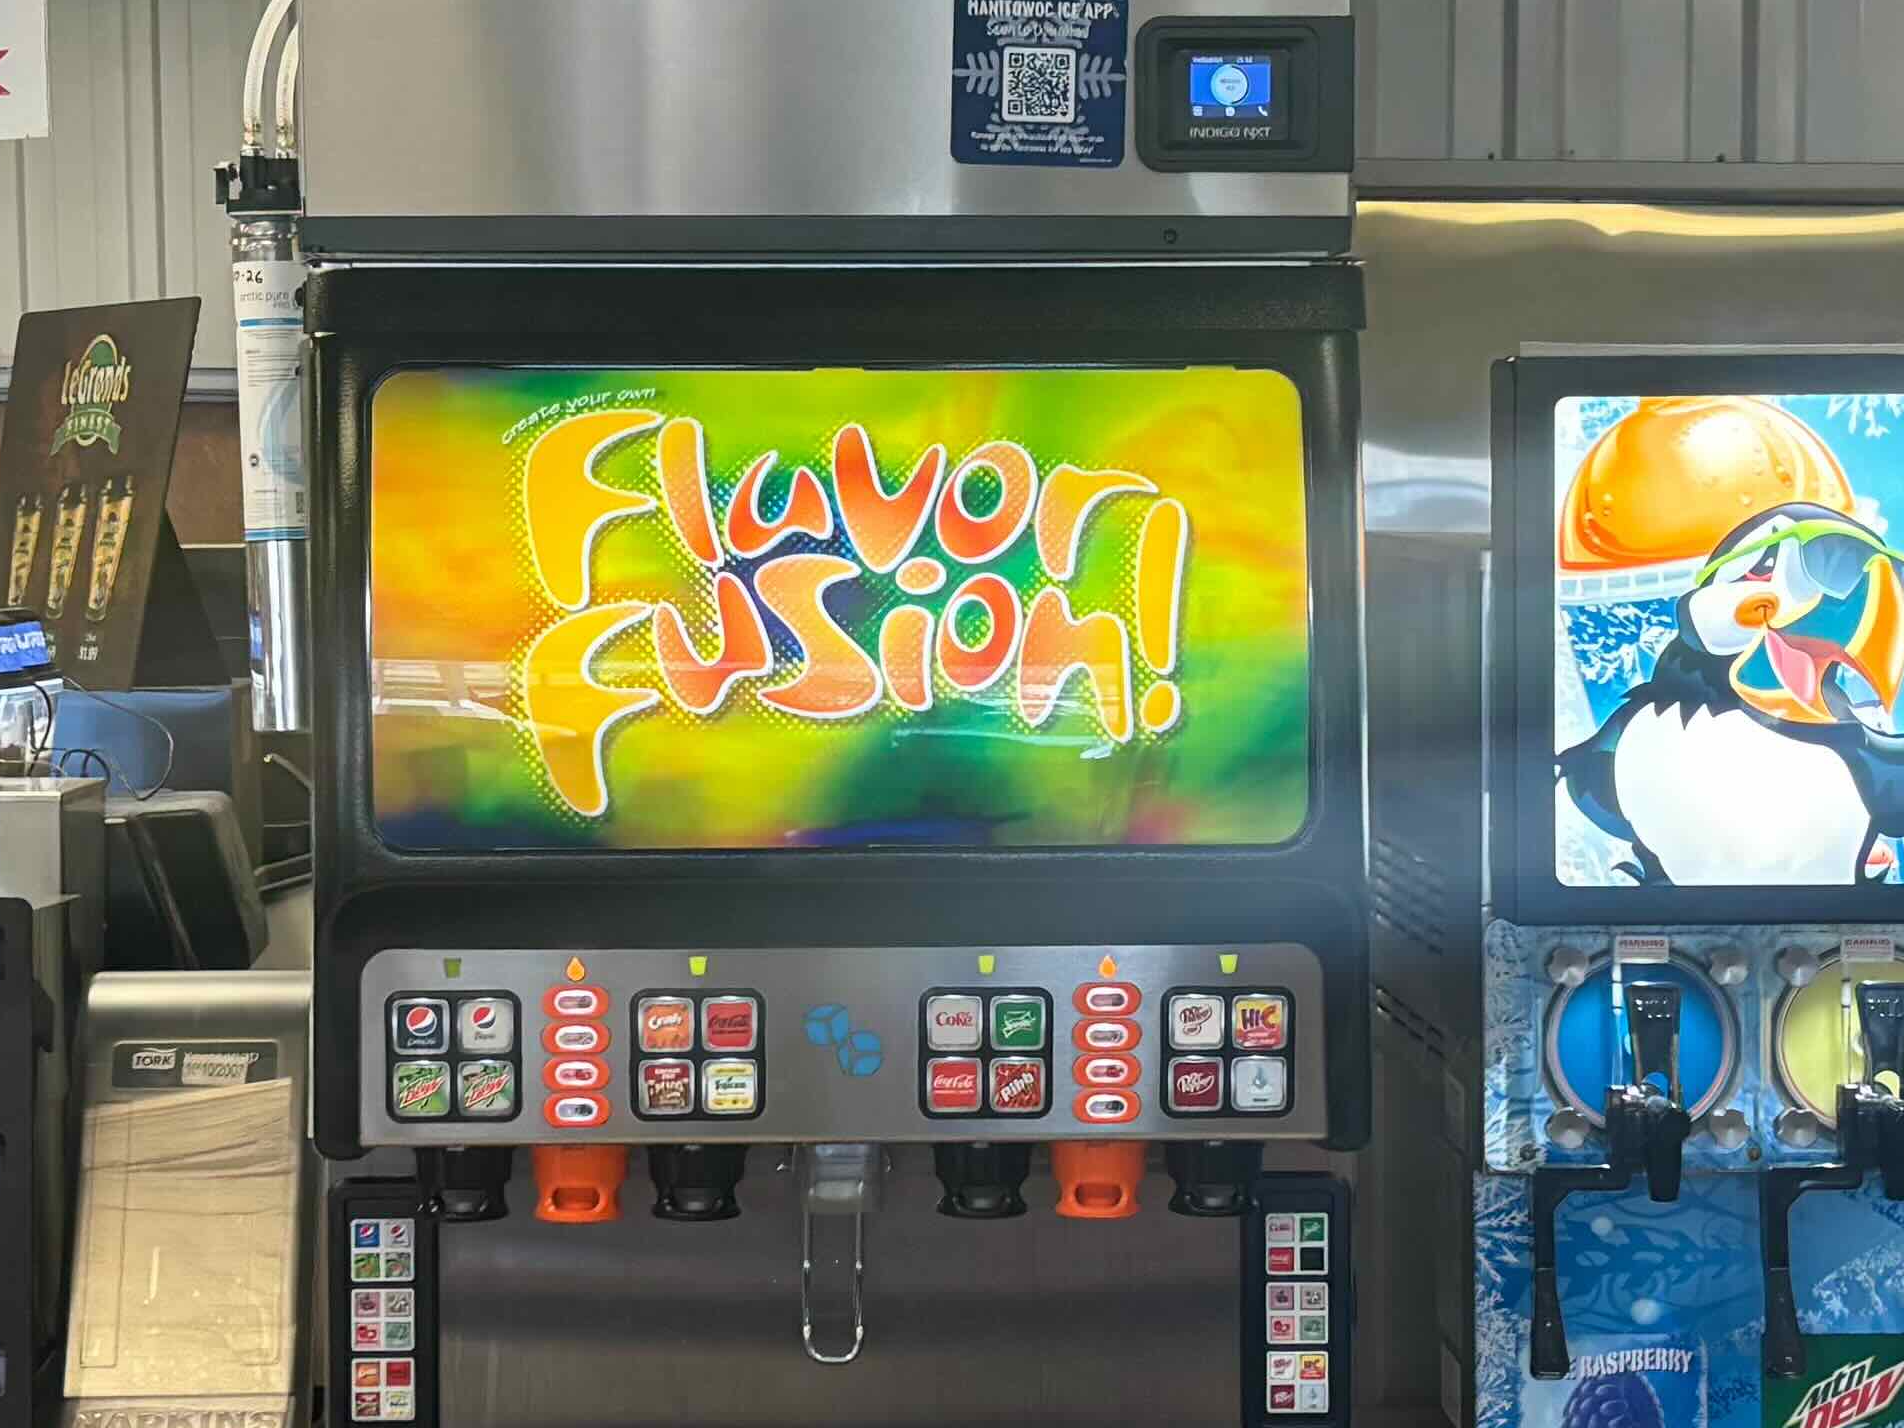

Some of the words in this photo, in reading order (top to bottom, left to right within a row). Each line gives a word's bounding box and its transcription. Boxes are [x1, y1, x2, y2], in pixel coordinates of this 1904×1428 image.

[968, 0, 1053, 17] MANITOWOC
[1057, 1, 1080, 18] ICE
[1084, 2, 1113, 19] APP
[1189, 127, 1240, 138] INDIGO
[61, 356, 131, 404] LeGrands
[501, 402, 561, 445] create
[565, 391, 611, 413] your
[617, 387, 656, 401] own
[524, 408, 1160, 612] Flavor
[135, 1054, 173, 1066] TORK
[1578, 1348, 1694, 1378] RASPBERRY
